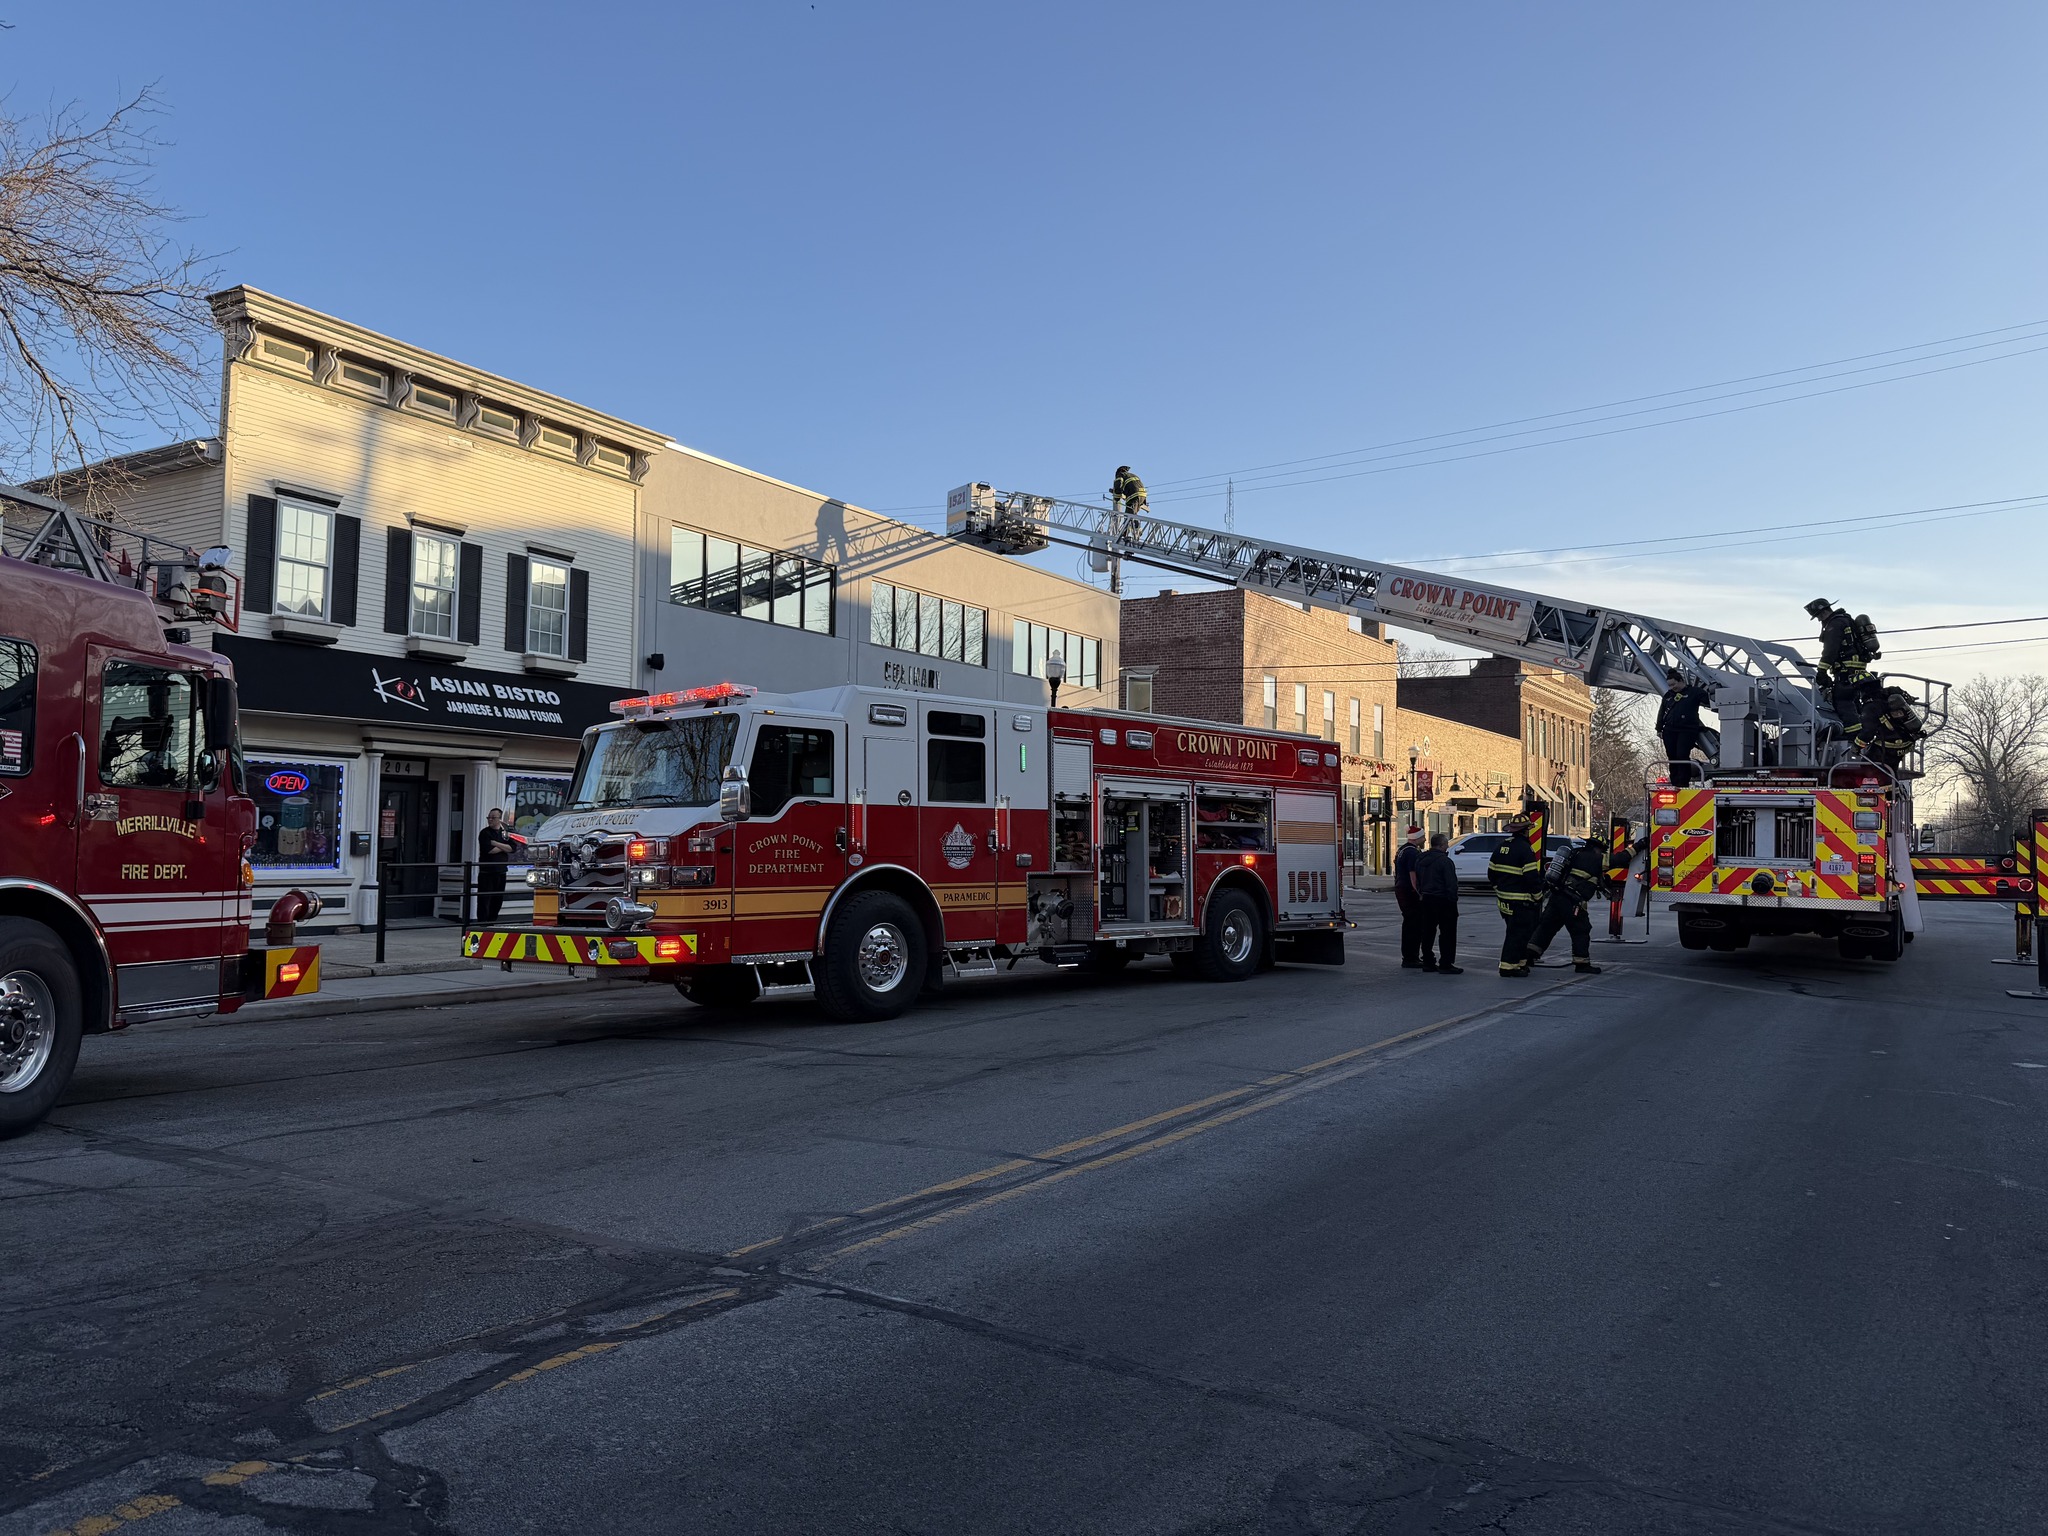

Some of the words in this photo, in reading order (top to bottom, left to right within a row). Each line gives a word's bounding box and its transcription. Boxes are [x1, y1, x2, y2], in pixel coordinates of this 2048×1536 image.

[949, 491, 966, 509] 1521
[1390, 577, 1457, 608] CROWN
[1459, 590, 1521, 621] POINT
[1415, 603, 1457, 620] Established
[429, 676, 491, 698] ASIAN
[492, 684, 561, 706] BISTRO
[446, 700, 494, 717] JAPANESE
[495, 705, 503, 718] &
[503, 706, 531, 721] ASIAN
[530, 711, 563, 724] FUSION
[1177, 732, 1232, 757] CROWN
[1237, 739, 1278, 761] POINT
[384, 761, 411, 774] 204
[1204, 758, 1239, 770] Established
[268, 775, 306, 791] OPEN
[116, 815, 197, 839] MERRILLVILLE
[570, 814, 604, 829] CROWN
[604, 813, 639, 826] POINT
[748, 834, 788, 854] CROWN
[792, 834, 824, 854] POINT
[774, 849, 801, 859] FIRE
[121, 864, 149, 879] FIRE
[154, 864, 188, 879] DEPT.
[748, 863, 825, 874] DEPARTMENT
[1288, 871, 1329, 904] 1511
[943, 891, 991, 902] PARAMEDIC
[702, 899, 728, 911] 3913
